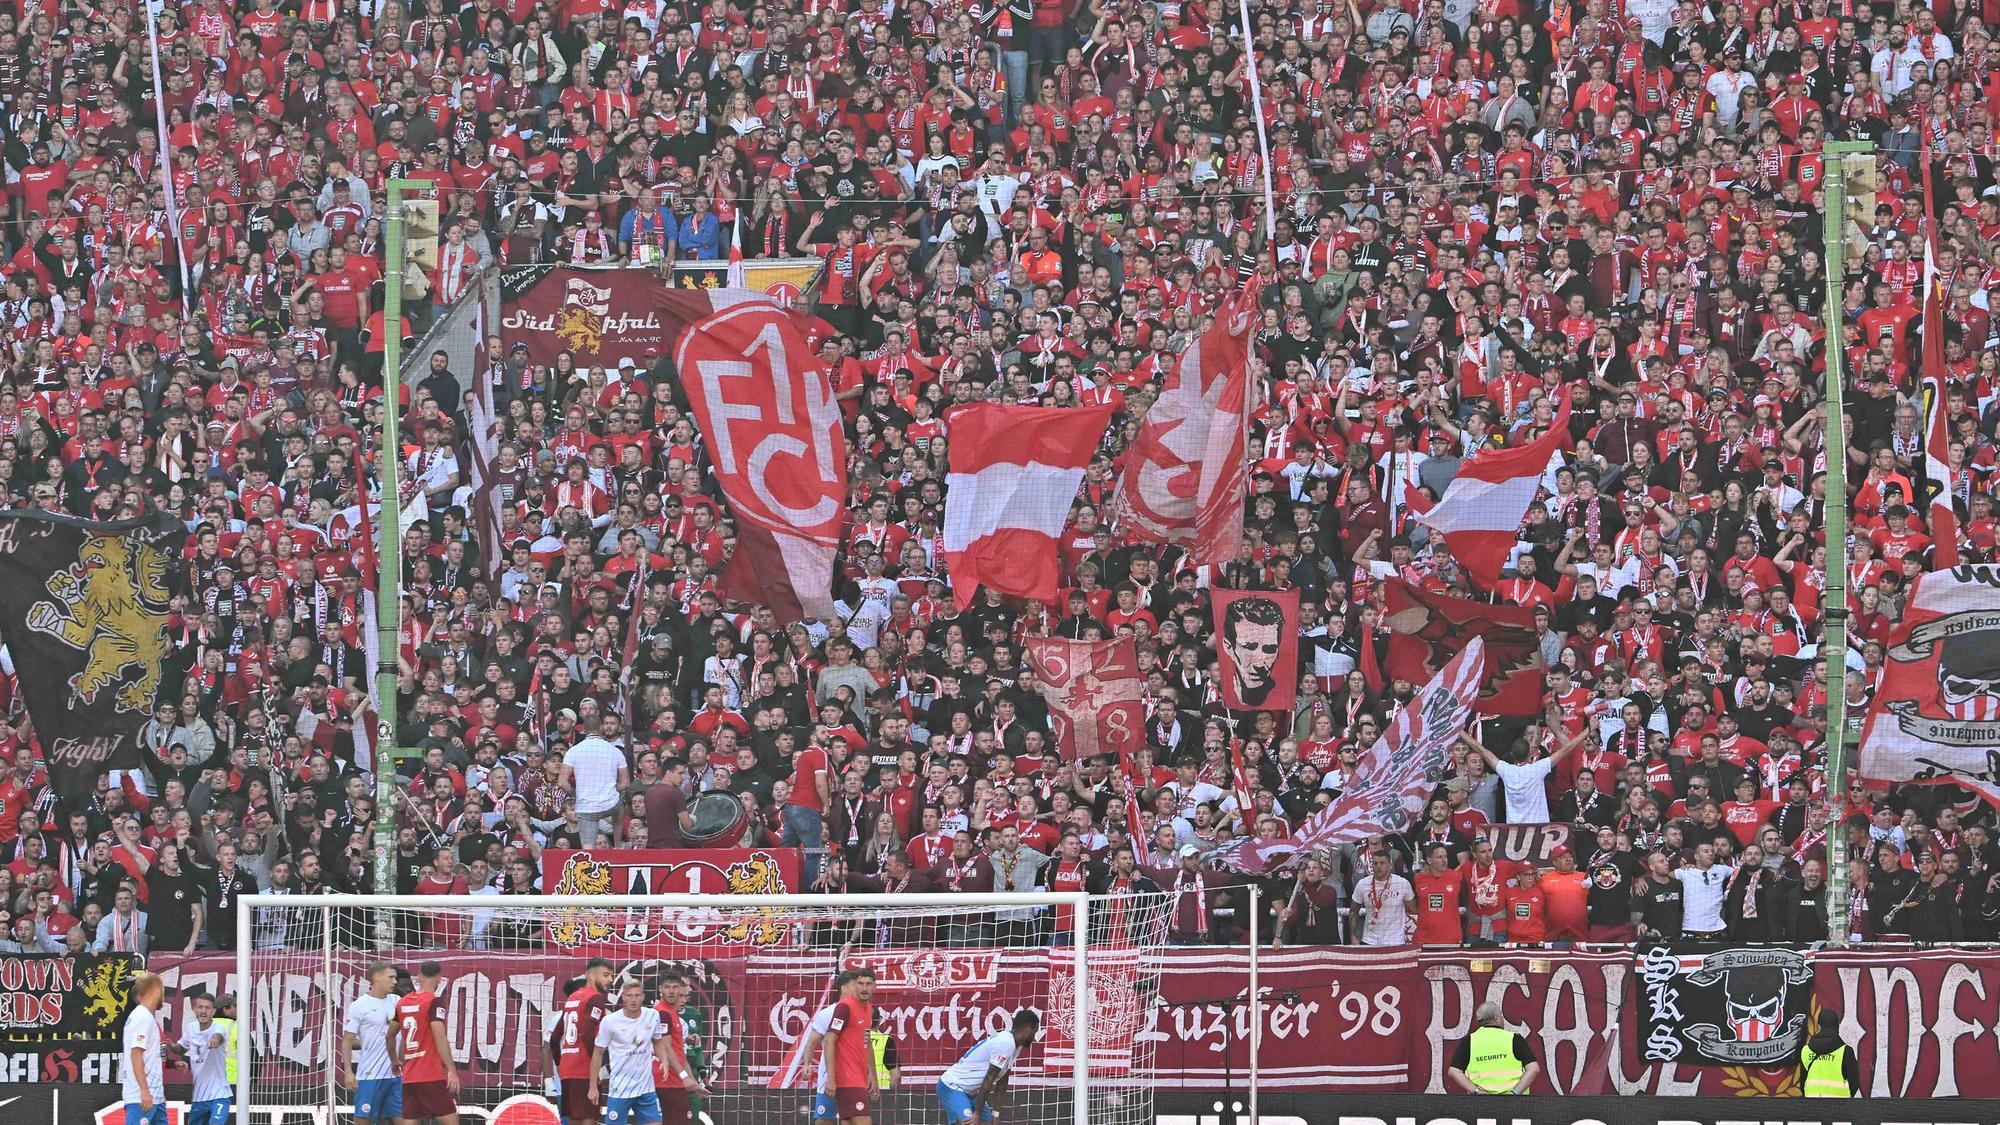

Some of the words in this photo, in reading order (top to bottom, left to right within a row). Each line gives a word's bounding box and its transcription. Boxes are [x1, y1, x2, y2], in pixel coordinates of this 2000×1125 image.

[502, 309, 556, 331] Süd
[0, 957, 75, 991] OWN
[950, 953, 996, 981] SV
[769, 992, 1047, 1044] Geration
[1837, 962, 2000, 1098] INF
[402, 1016, 421, 1050] 2
[1475, 1053, 1508, 1062] SECURITY
[1726, 1041, 1787, 1058] Kompanie
[1808, 1053, 1836, 1062] SEURITY
[216, 1103, 224, 1116] 7
